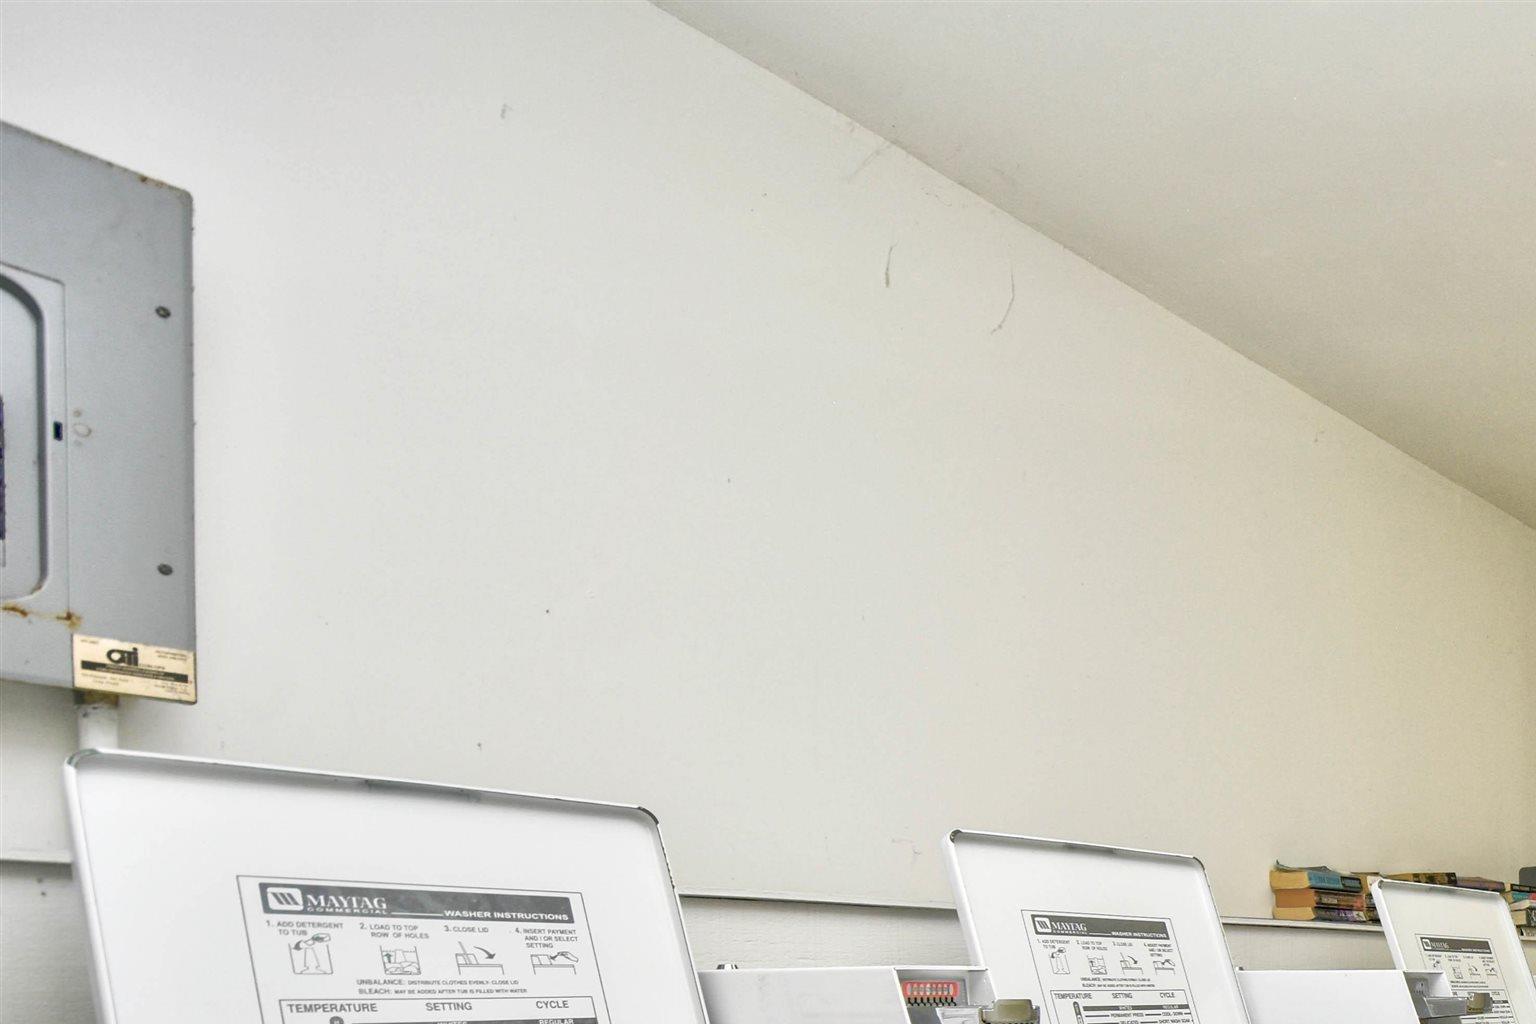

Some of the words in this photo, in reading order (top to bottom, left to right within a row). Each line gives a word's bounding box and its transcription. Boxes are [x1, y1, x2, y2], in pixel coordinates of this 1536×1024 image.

[306, 895, 388, 910] MAYTAG
[443, 910, 491, 919] WASHER
[493, 911, 569, 921] INSTRUCTIONS
[295, 921, 344, 930] DETERGENT
[359, 922, 367, 930] 2.
[1050, 921, 1087, 932] MAYTAG
[1054, 992, 1093, 1000] TEMPERATURE
[287, 1003, 378, 1013] TEMPERATURE
[425, 1001, 473, 1012] SETTING
[535, 1000, 570, 1010] CYCLE
